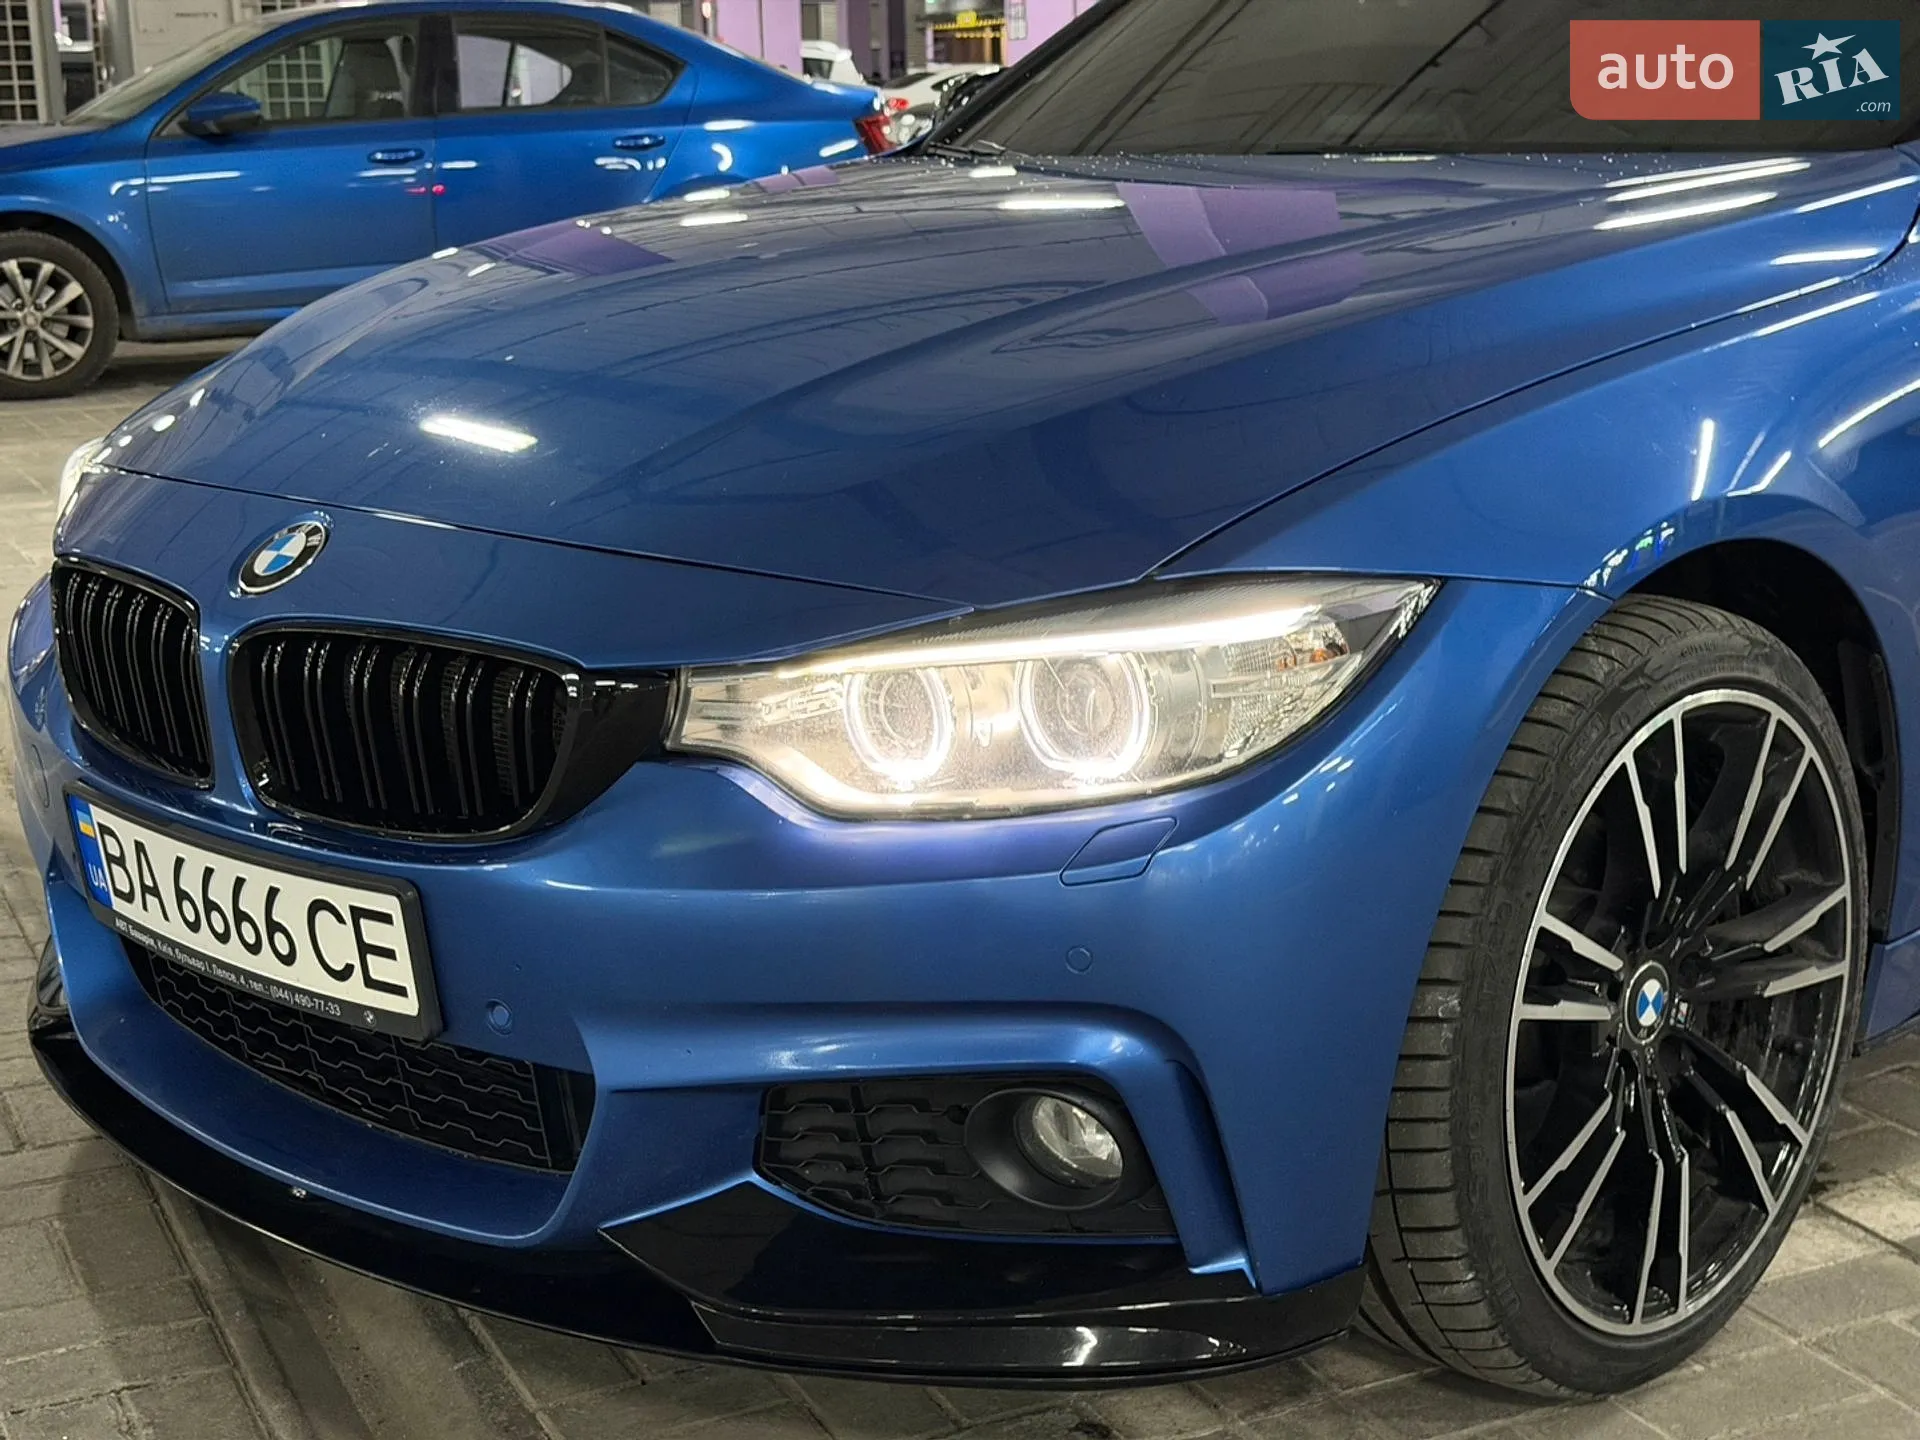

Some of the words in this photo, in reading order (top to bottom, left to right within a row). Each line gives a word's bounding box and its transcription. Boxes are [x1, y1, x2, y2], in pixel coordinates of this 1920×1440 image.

[88, 862, 109, 893] UA
[96, 820, 170, 923] BA
[173, 854, 298, 968] 6666
[307, 897, 410, 999] CE
